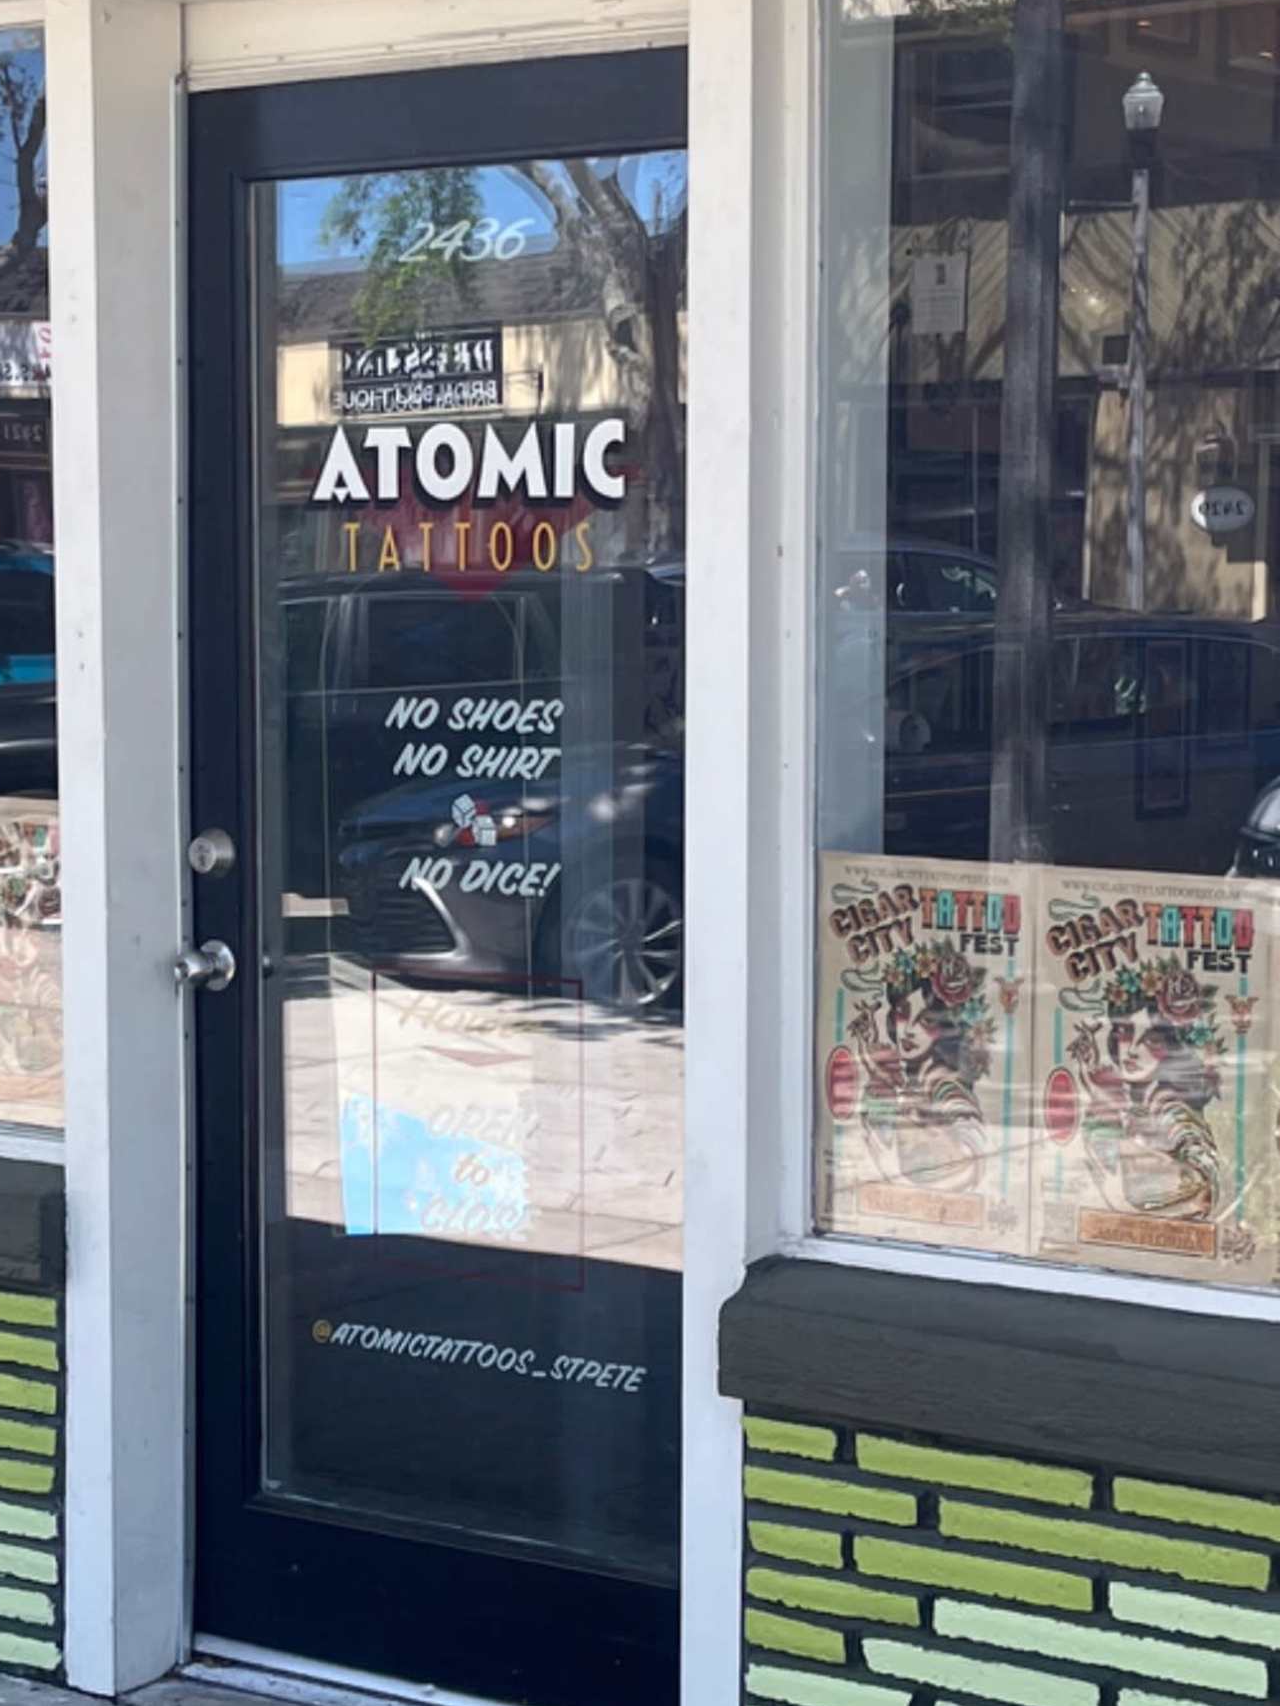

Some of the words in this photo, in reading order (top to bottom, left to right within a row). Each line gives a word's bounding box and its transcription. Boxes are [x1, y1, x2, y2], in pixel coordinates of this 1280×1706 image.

[398, 217, 534, 263] 2436
[312, 419, 627, 505] ATOMIC
[343, 521, 595, 573] TATTOOS
[385, 697, 440, 730] NO
[447, 698, 564, 734] SHOES
[393, 743, 448, 776] NO
[454, 744, 562, 780] SHIRT
[398, 857, 453, 891] NO
[459, 859, 562, 898] DICE!
[829, 883, 920, 939] CIGAR
[919, 888, 1020, 934] TATTOO
[1045, 898, 1145, 956] CIGAR
[1142, 902, 1254, 951] TATTOO
[847, 917, 915, 964] CITY
[960, 934, 1019, 955] FEST
[1066, 932, 1139, 983] CITY
[1185, 950, 1252, 974] FEST
[426, 1101, 541, 1144] OPEN
[454, 1152, 491, 1186] to
[312, 1319, 646, 1392] @ATOMICTATTOOS_STPETE
